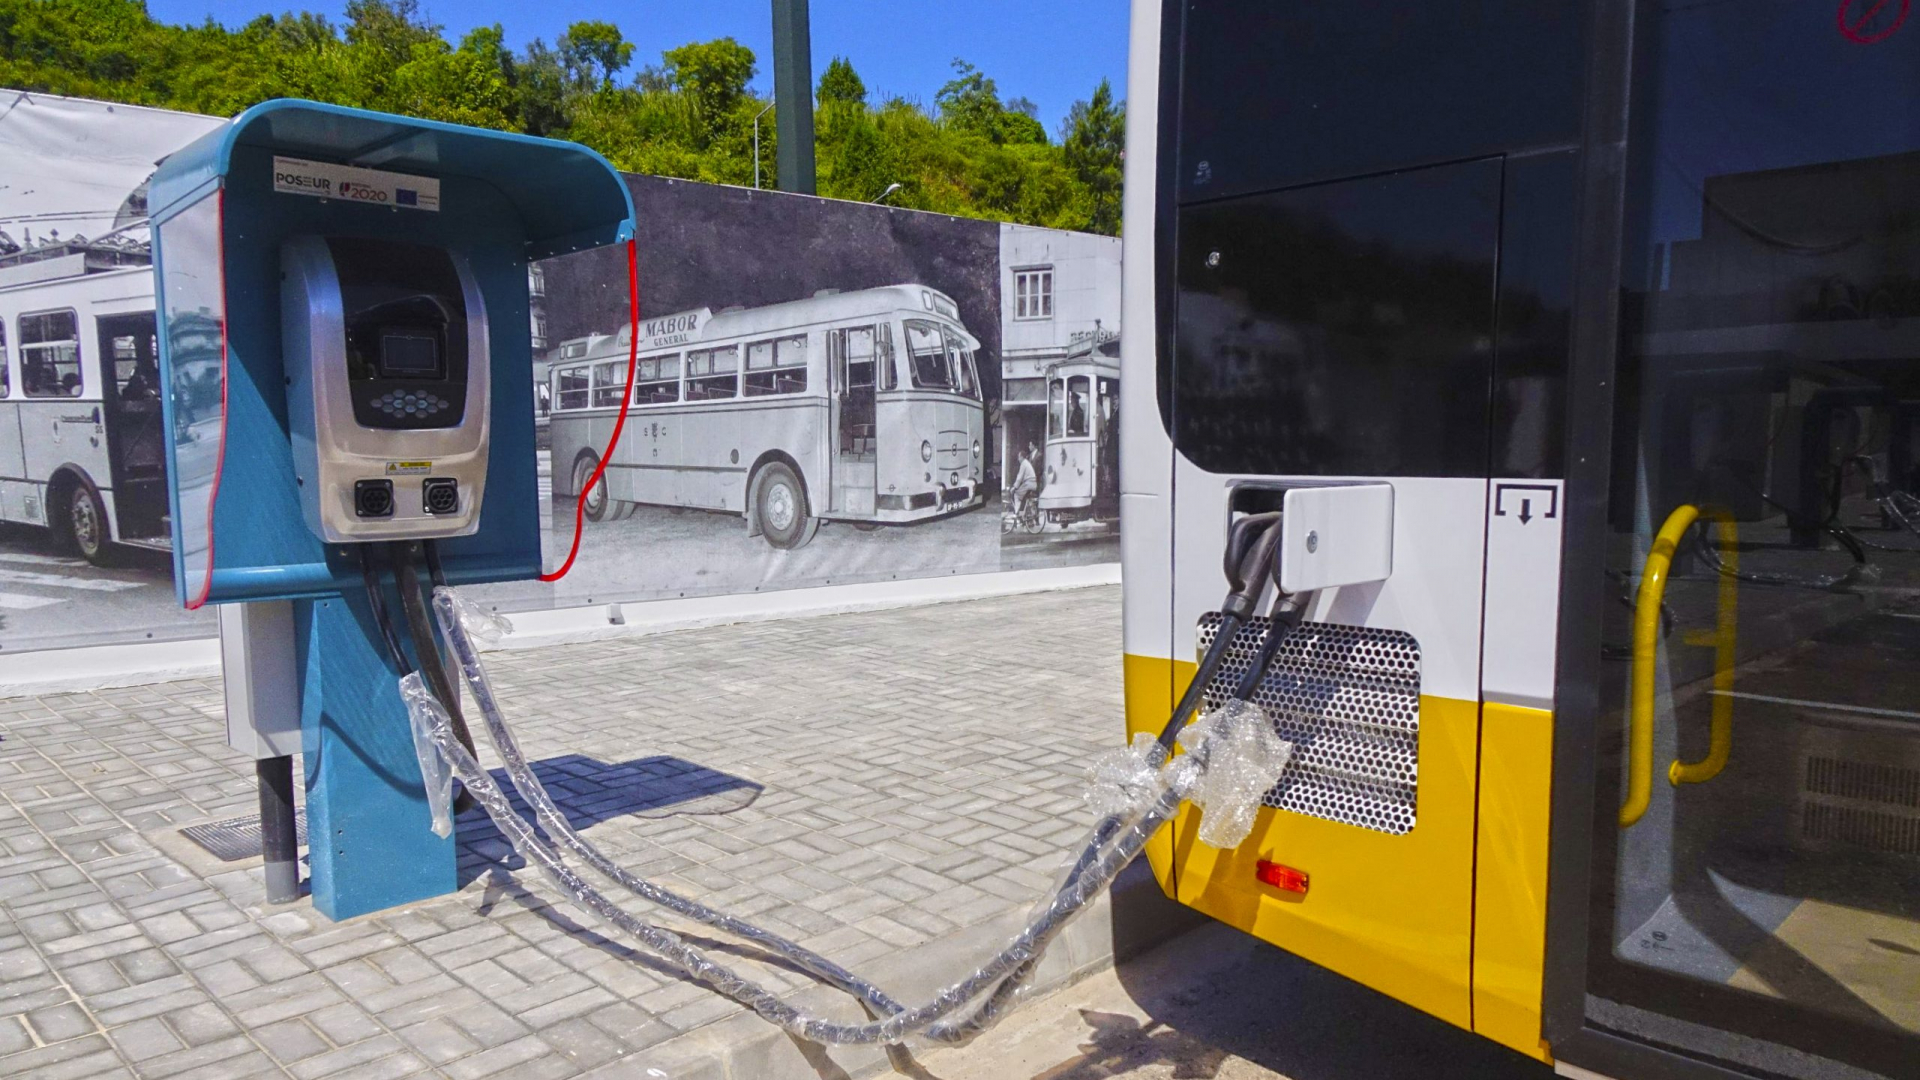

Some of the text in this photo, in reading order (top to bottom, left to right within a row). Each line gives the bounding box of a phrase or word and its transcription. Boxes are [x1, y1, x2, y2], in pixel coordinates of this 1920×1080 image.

[275, 172, 331, 190] POSEUR
[351, 187, 388, 201] 2020
[646, 314, 697, 338] MABOR
[653, 333, 689, 347] GENERAL
